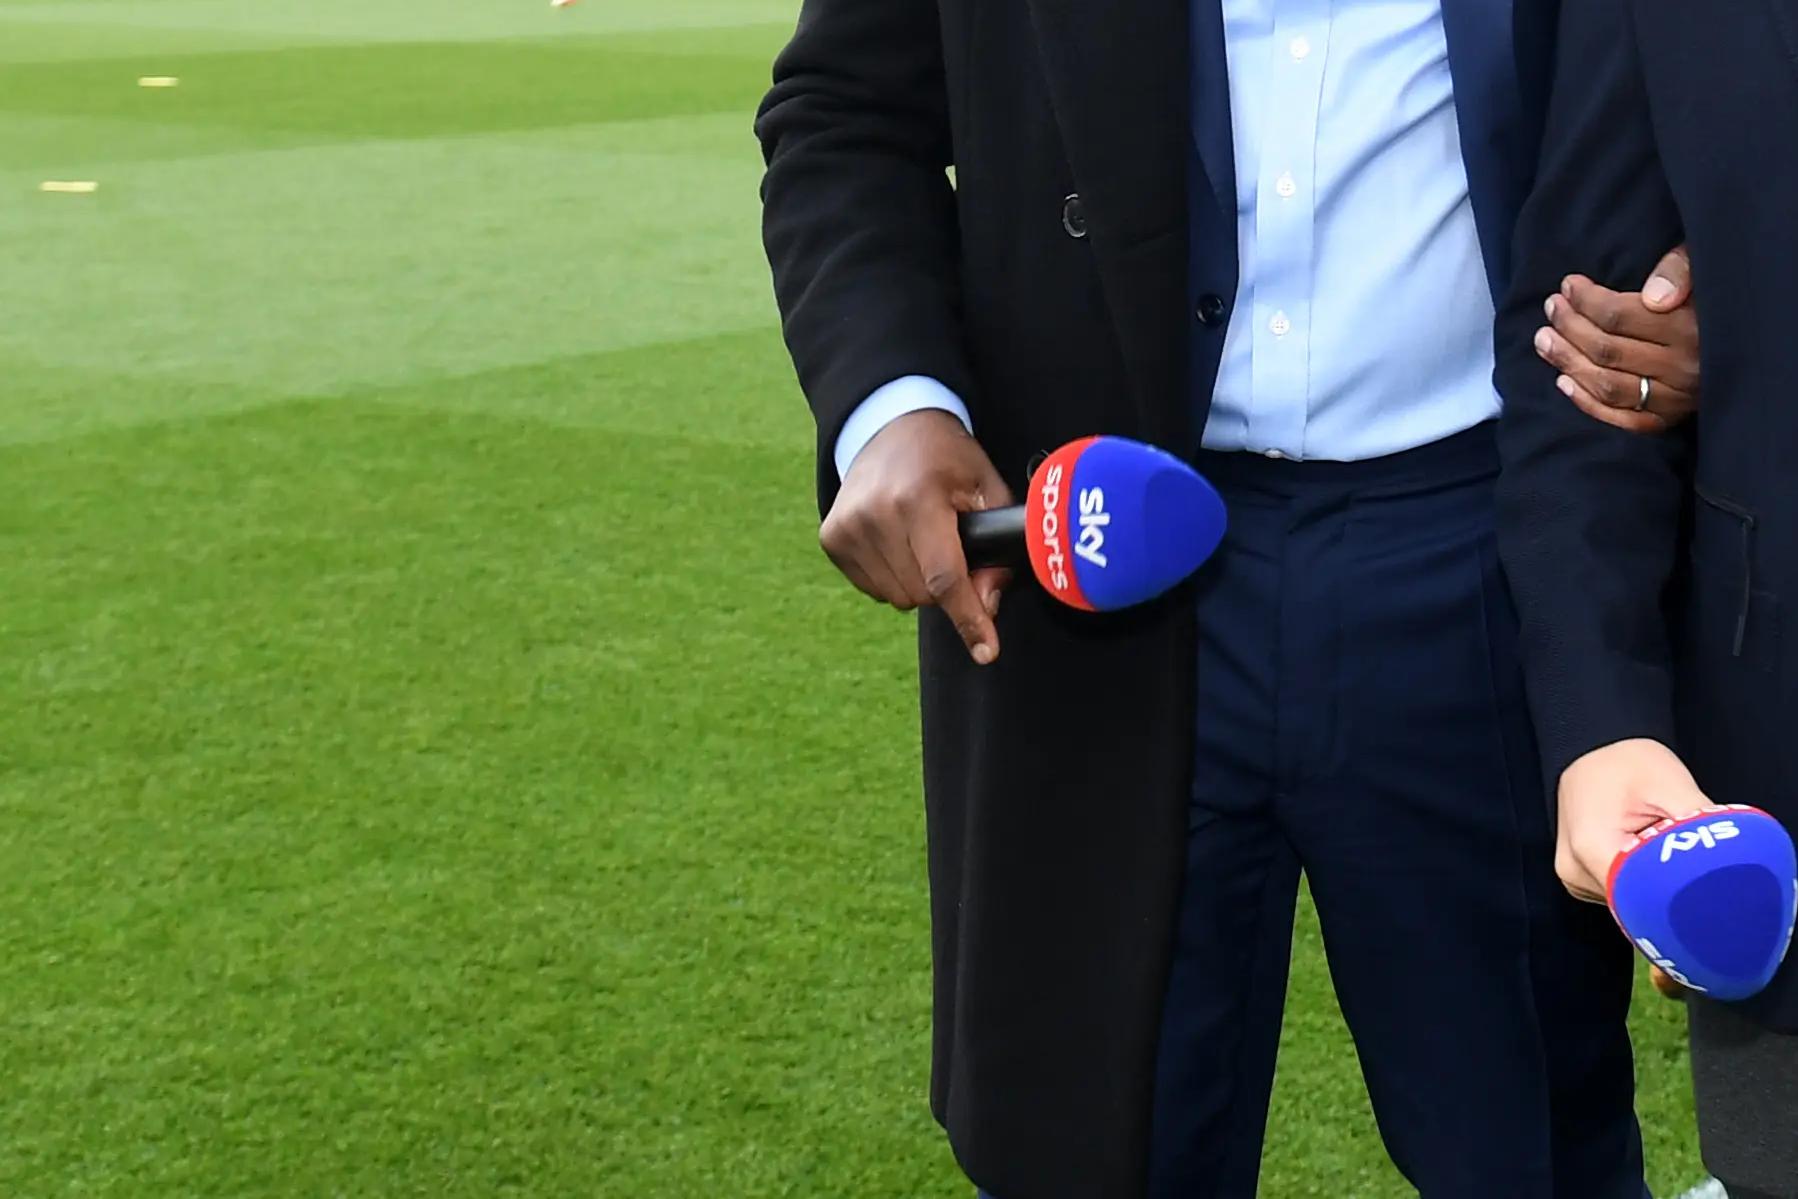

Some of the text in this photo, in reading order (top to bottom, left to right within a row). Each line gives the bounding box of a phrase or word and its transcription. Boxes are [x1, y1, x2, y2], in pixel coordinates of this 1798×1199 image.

[1042, 464, 1068, 591] sports
[1074, 486, 1111, 569] sky
[1659, 820, 1741, 863] sky
